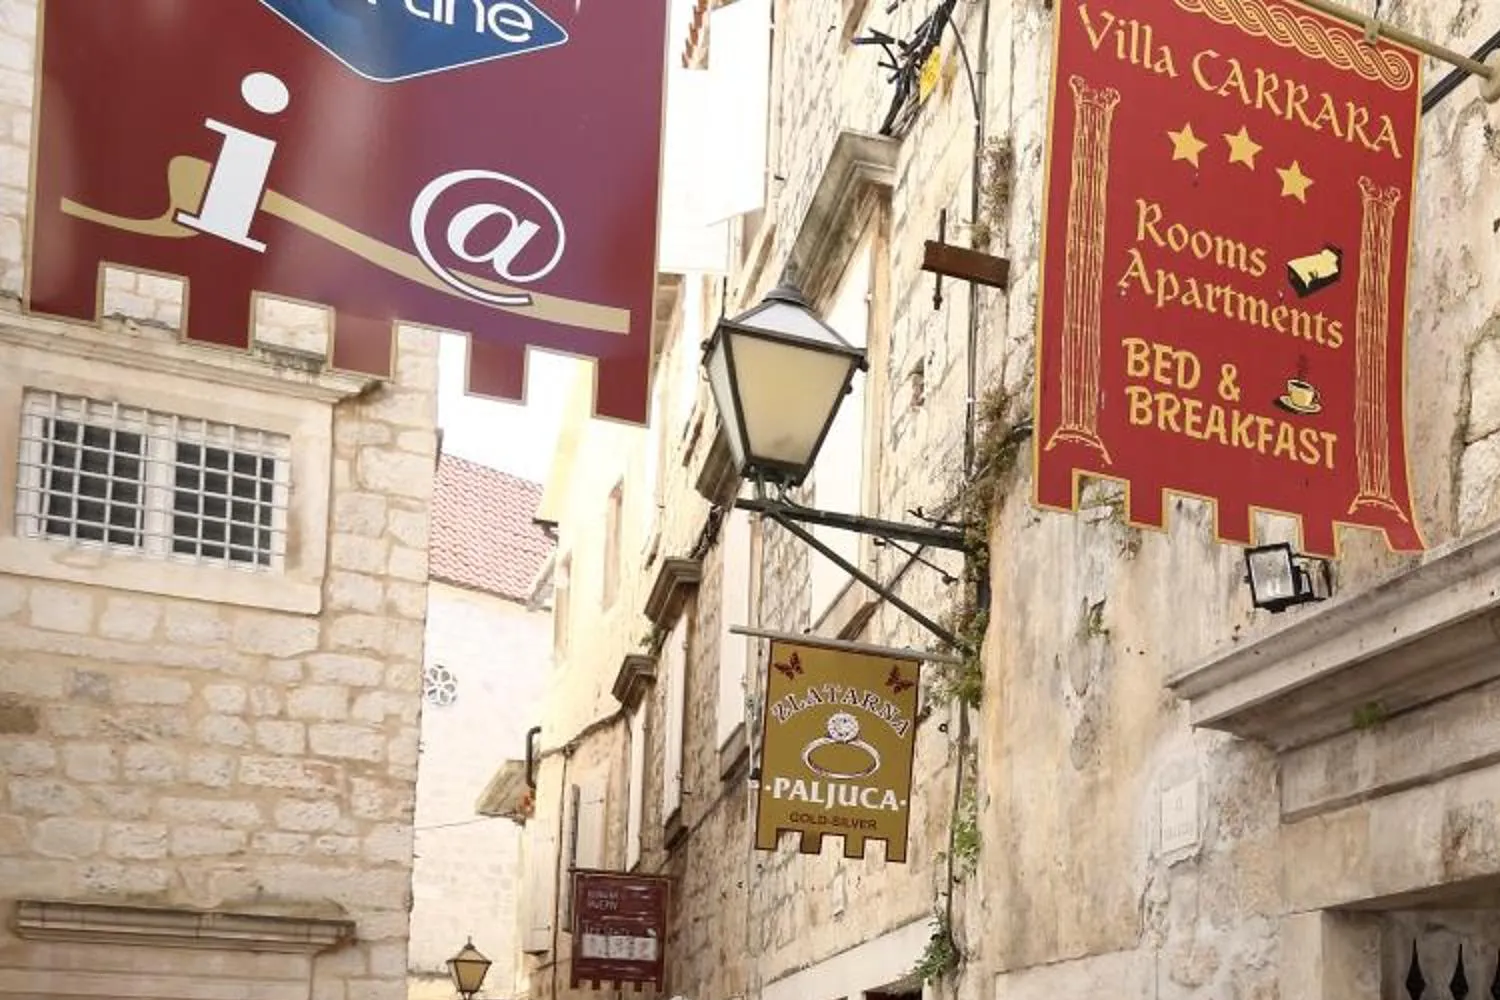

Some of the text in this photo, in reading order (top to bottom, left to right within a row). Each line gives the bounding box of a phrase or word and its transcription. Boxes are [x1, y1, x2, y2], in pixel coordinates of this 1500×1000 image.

[1078, 3, 1402, 160] Villa CARRARA
[1136, 199, 1268, 277] Rooms
[1117, 248, 1344, 349] Apartments
[1121, 337, 1241, 401] BED &
[1124, 386, 1338, 470] BREAKFAST
[770, 683, 911, 739] ZLATARNA
[772, 776, 900, 812] PALJUCA
